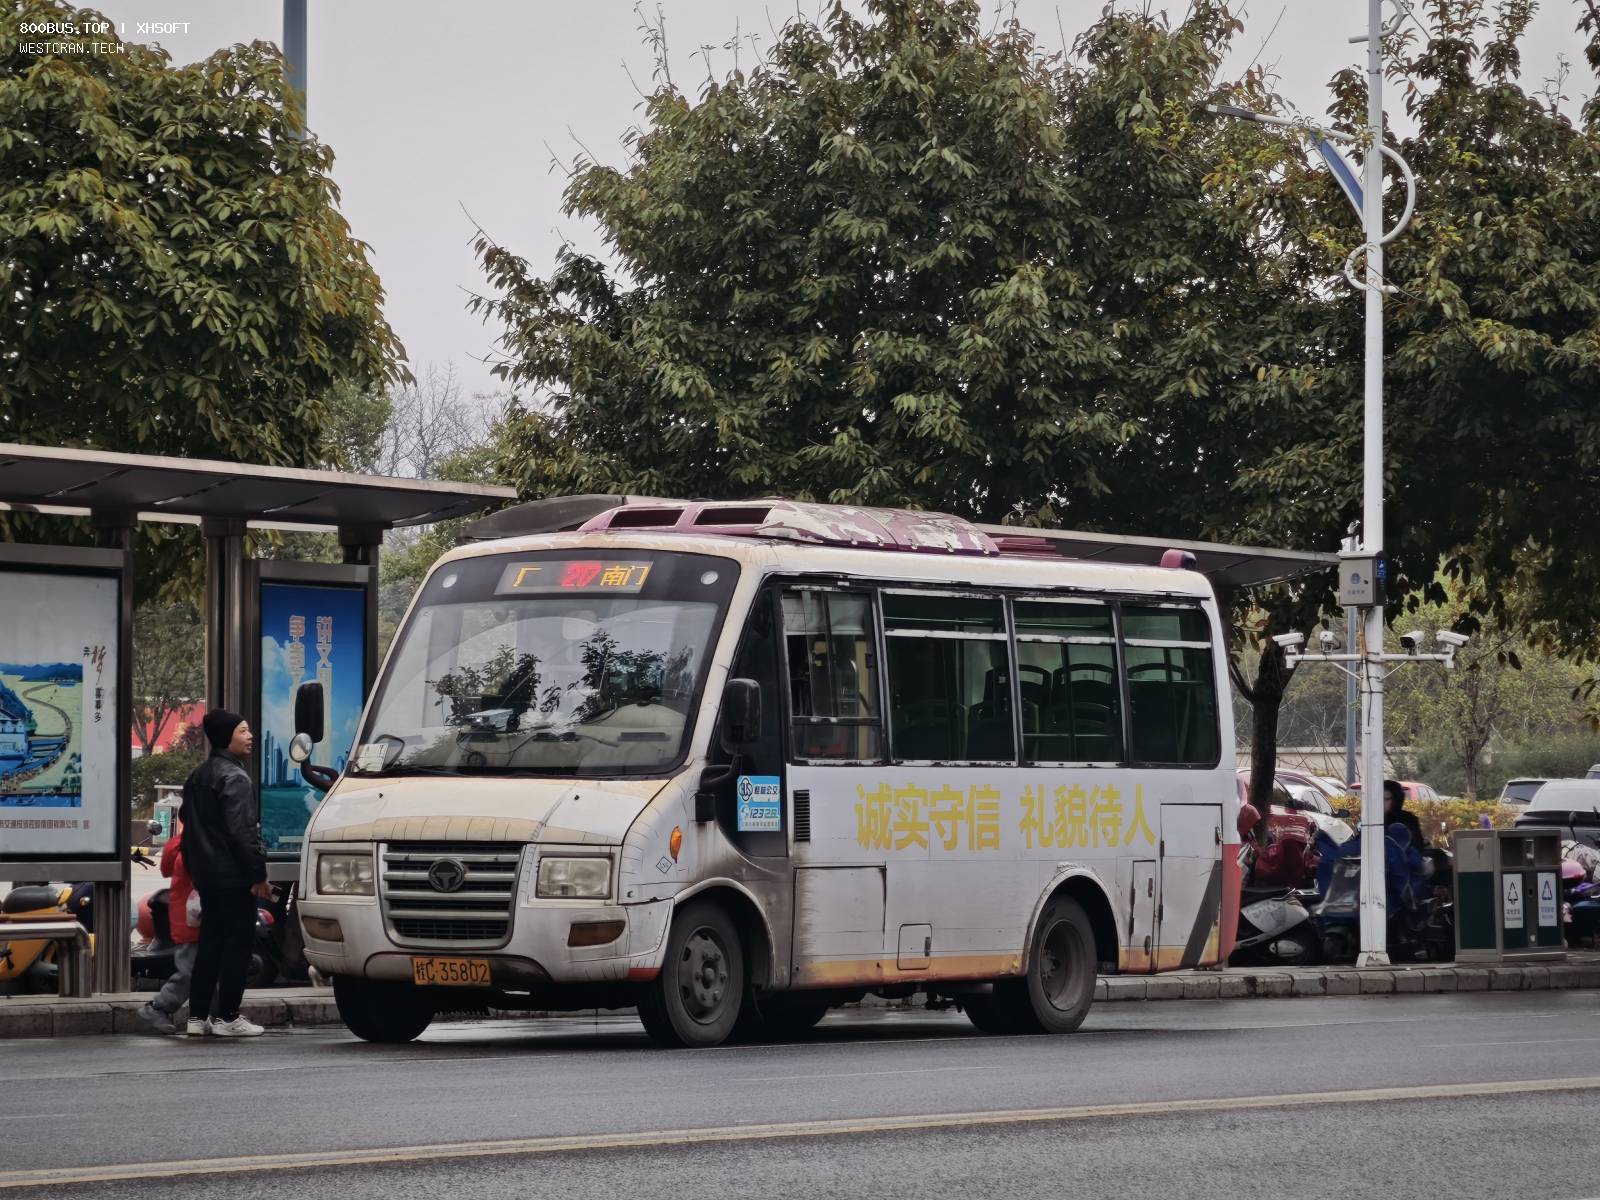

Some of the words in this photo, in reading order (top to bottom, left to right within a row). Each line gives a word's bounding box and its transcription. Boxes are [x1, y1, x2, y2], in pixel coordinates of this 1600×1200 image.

[600, 565, 650, 587] 南门
[855, 783, 1000, 851] 诚实守信
[1019, 783, 1157, 850] 礼貌待人
